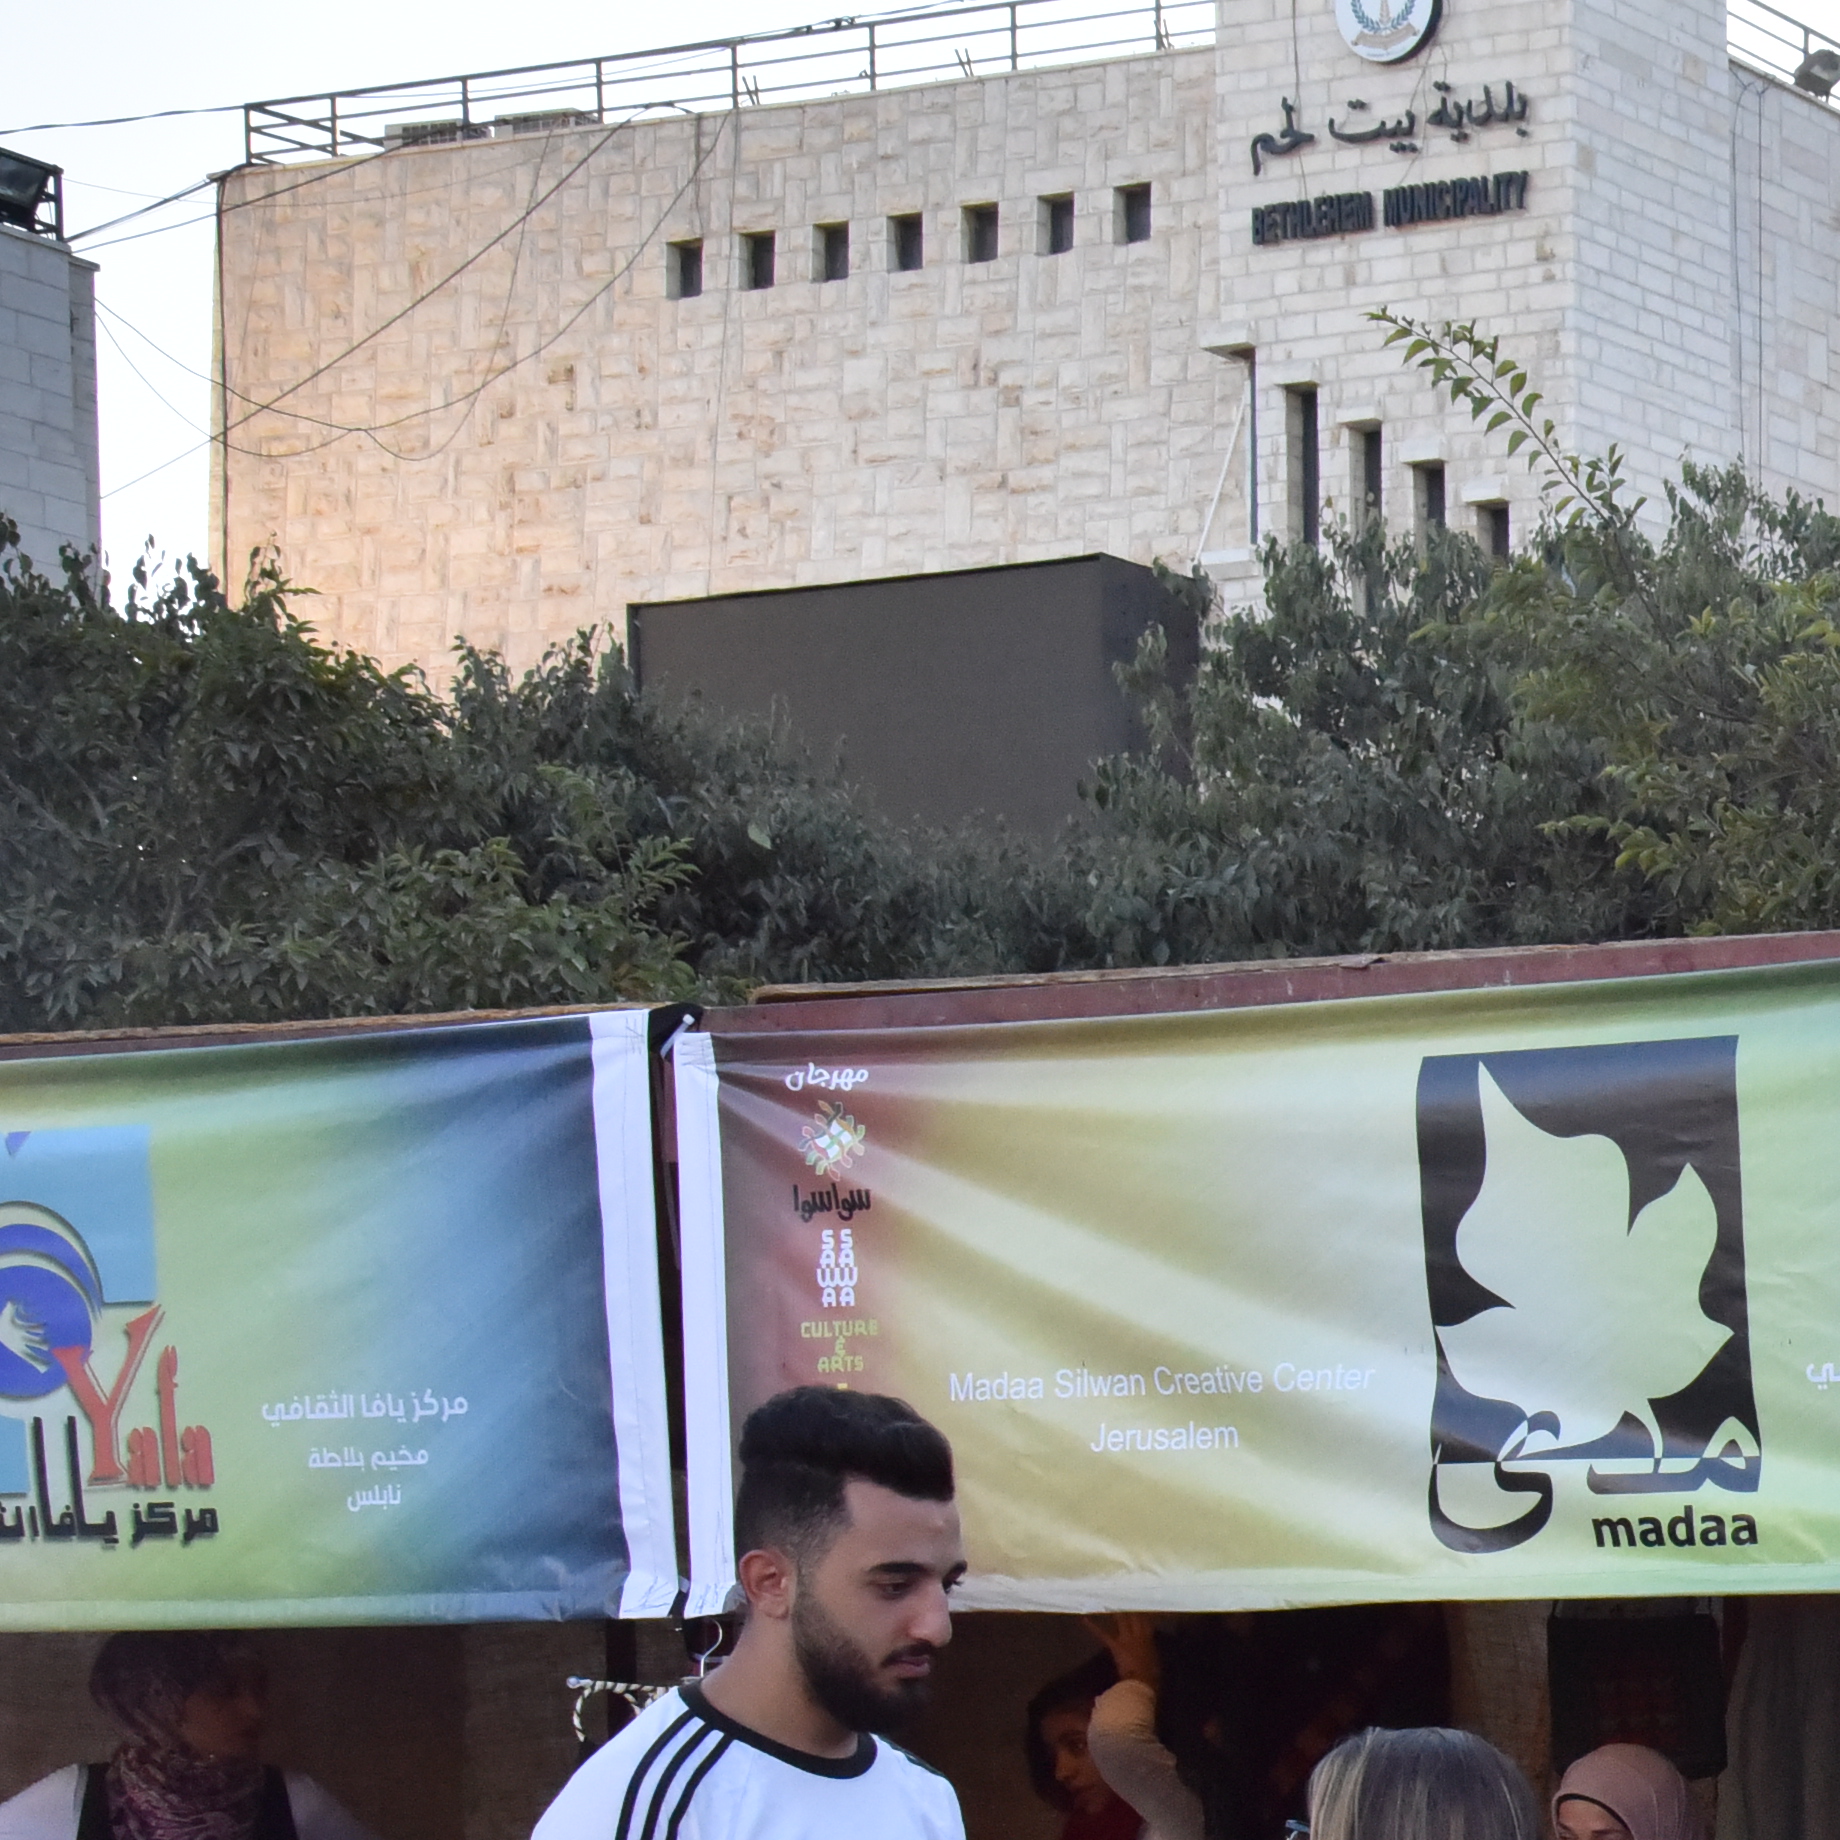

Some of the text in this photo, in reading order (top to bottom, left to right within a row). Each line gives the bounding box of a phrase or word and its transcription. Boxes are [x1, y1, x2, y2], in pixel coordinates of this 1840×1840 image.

[1250, 80, 1529, 176] بلدية بيت لحم
[1252, 170, 1529, 245] BETHLEHEM MUNICIPALITY
[785, 1062, 870, 1091] مهرجان
[800, 1318, 879, 1339] CULTURE
[817, 1355, 864, 1373] ARTS
[949, 1362, 1376, 1401] Madaa Silwan Creative Center
[262, 1388, 468, 1428] مركز يافا الثقافي
[1090, 1421, 1240, 1452] Jerusalem
[308, 1445, 429, 1471] مخيم بلاطة
[347, 1484, 401, 1512] نابلس
[130, 1501, 219, 1545] مركز
[1591, 1504, 1759, 1548] madaa
